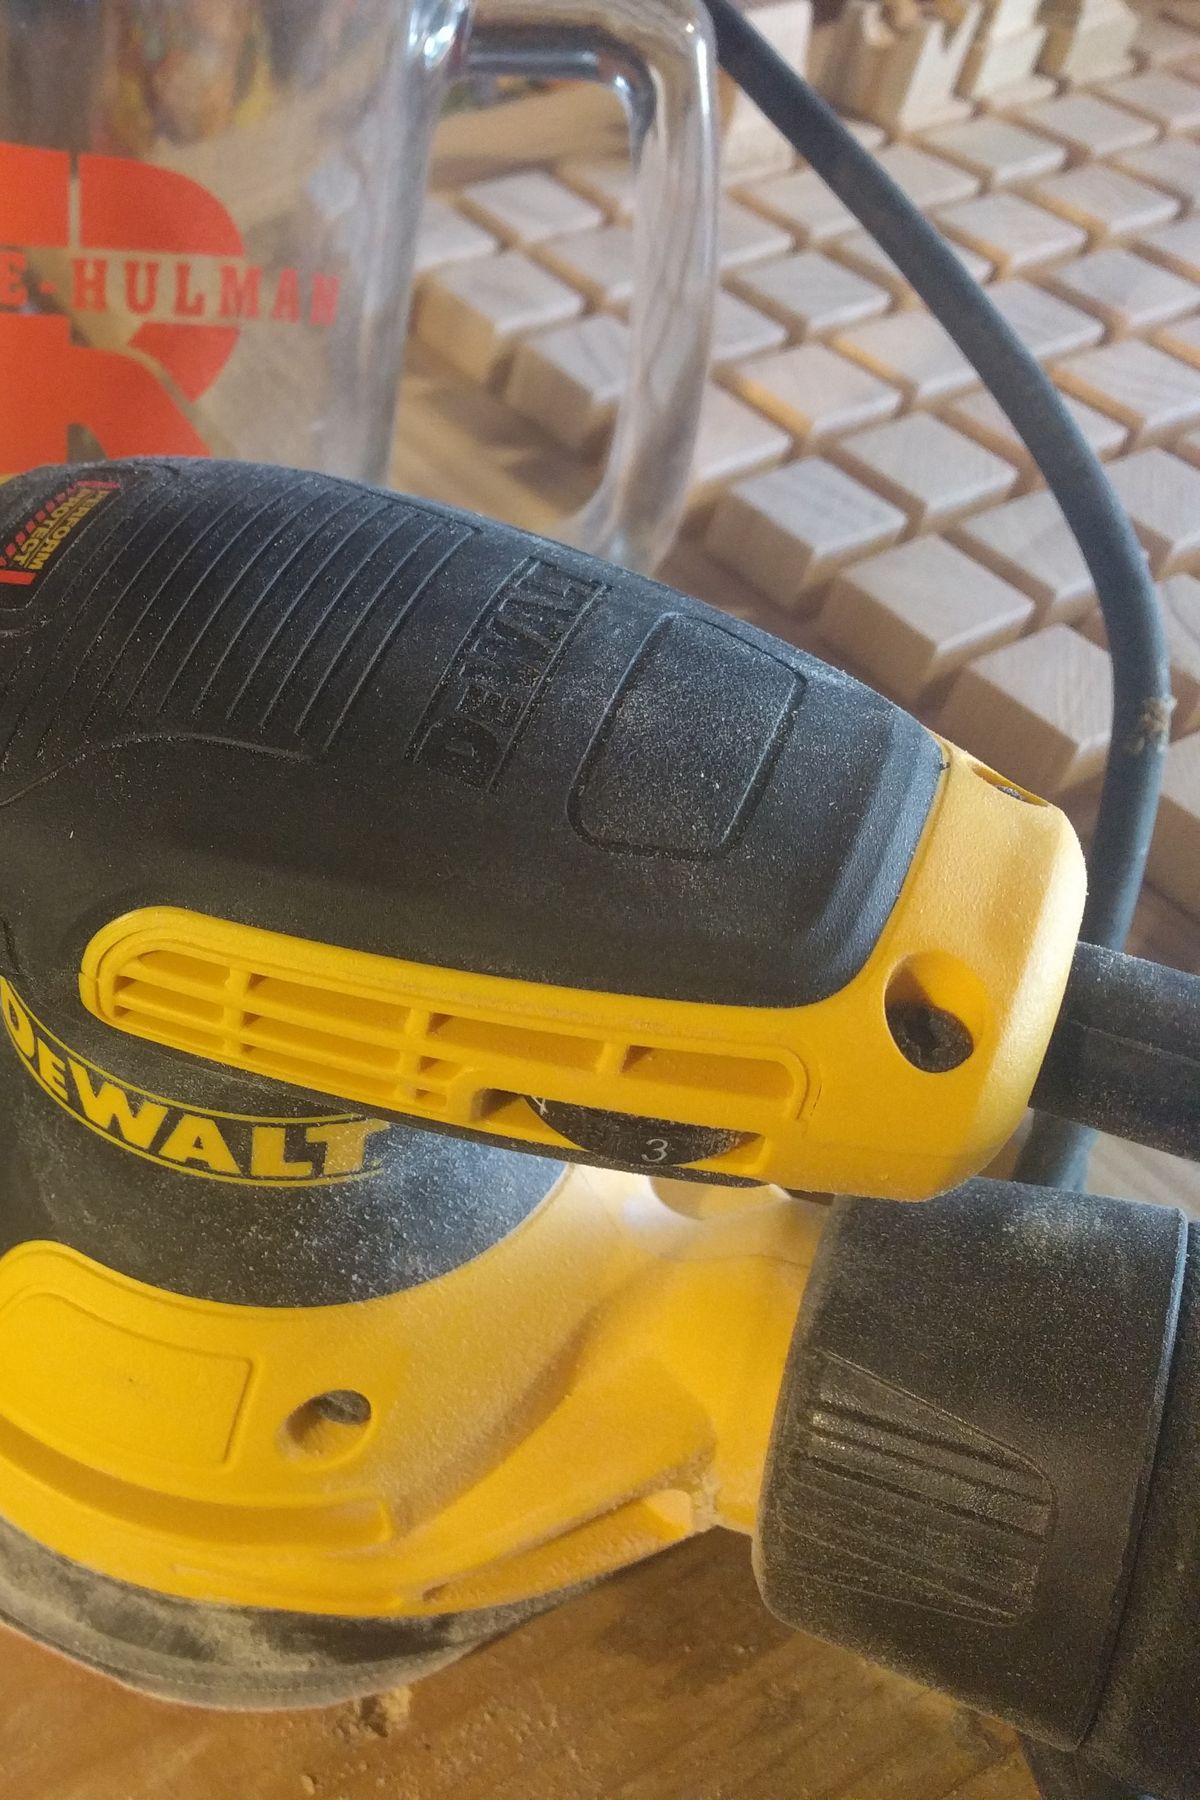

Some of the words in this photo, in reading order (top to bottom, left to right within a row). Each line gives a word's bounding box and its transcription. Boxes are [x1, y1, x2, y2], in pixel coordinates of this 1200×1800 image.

[12, 487, 94, 568] PROTECT
[27, 490, 112, 570] PERFORM
[0, 981, 390, 1176] DEWALT
[641, 1138, 669, 1163] 3
